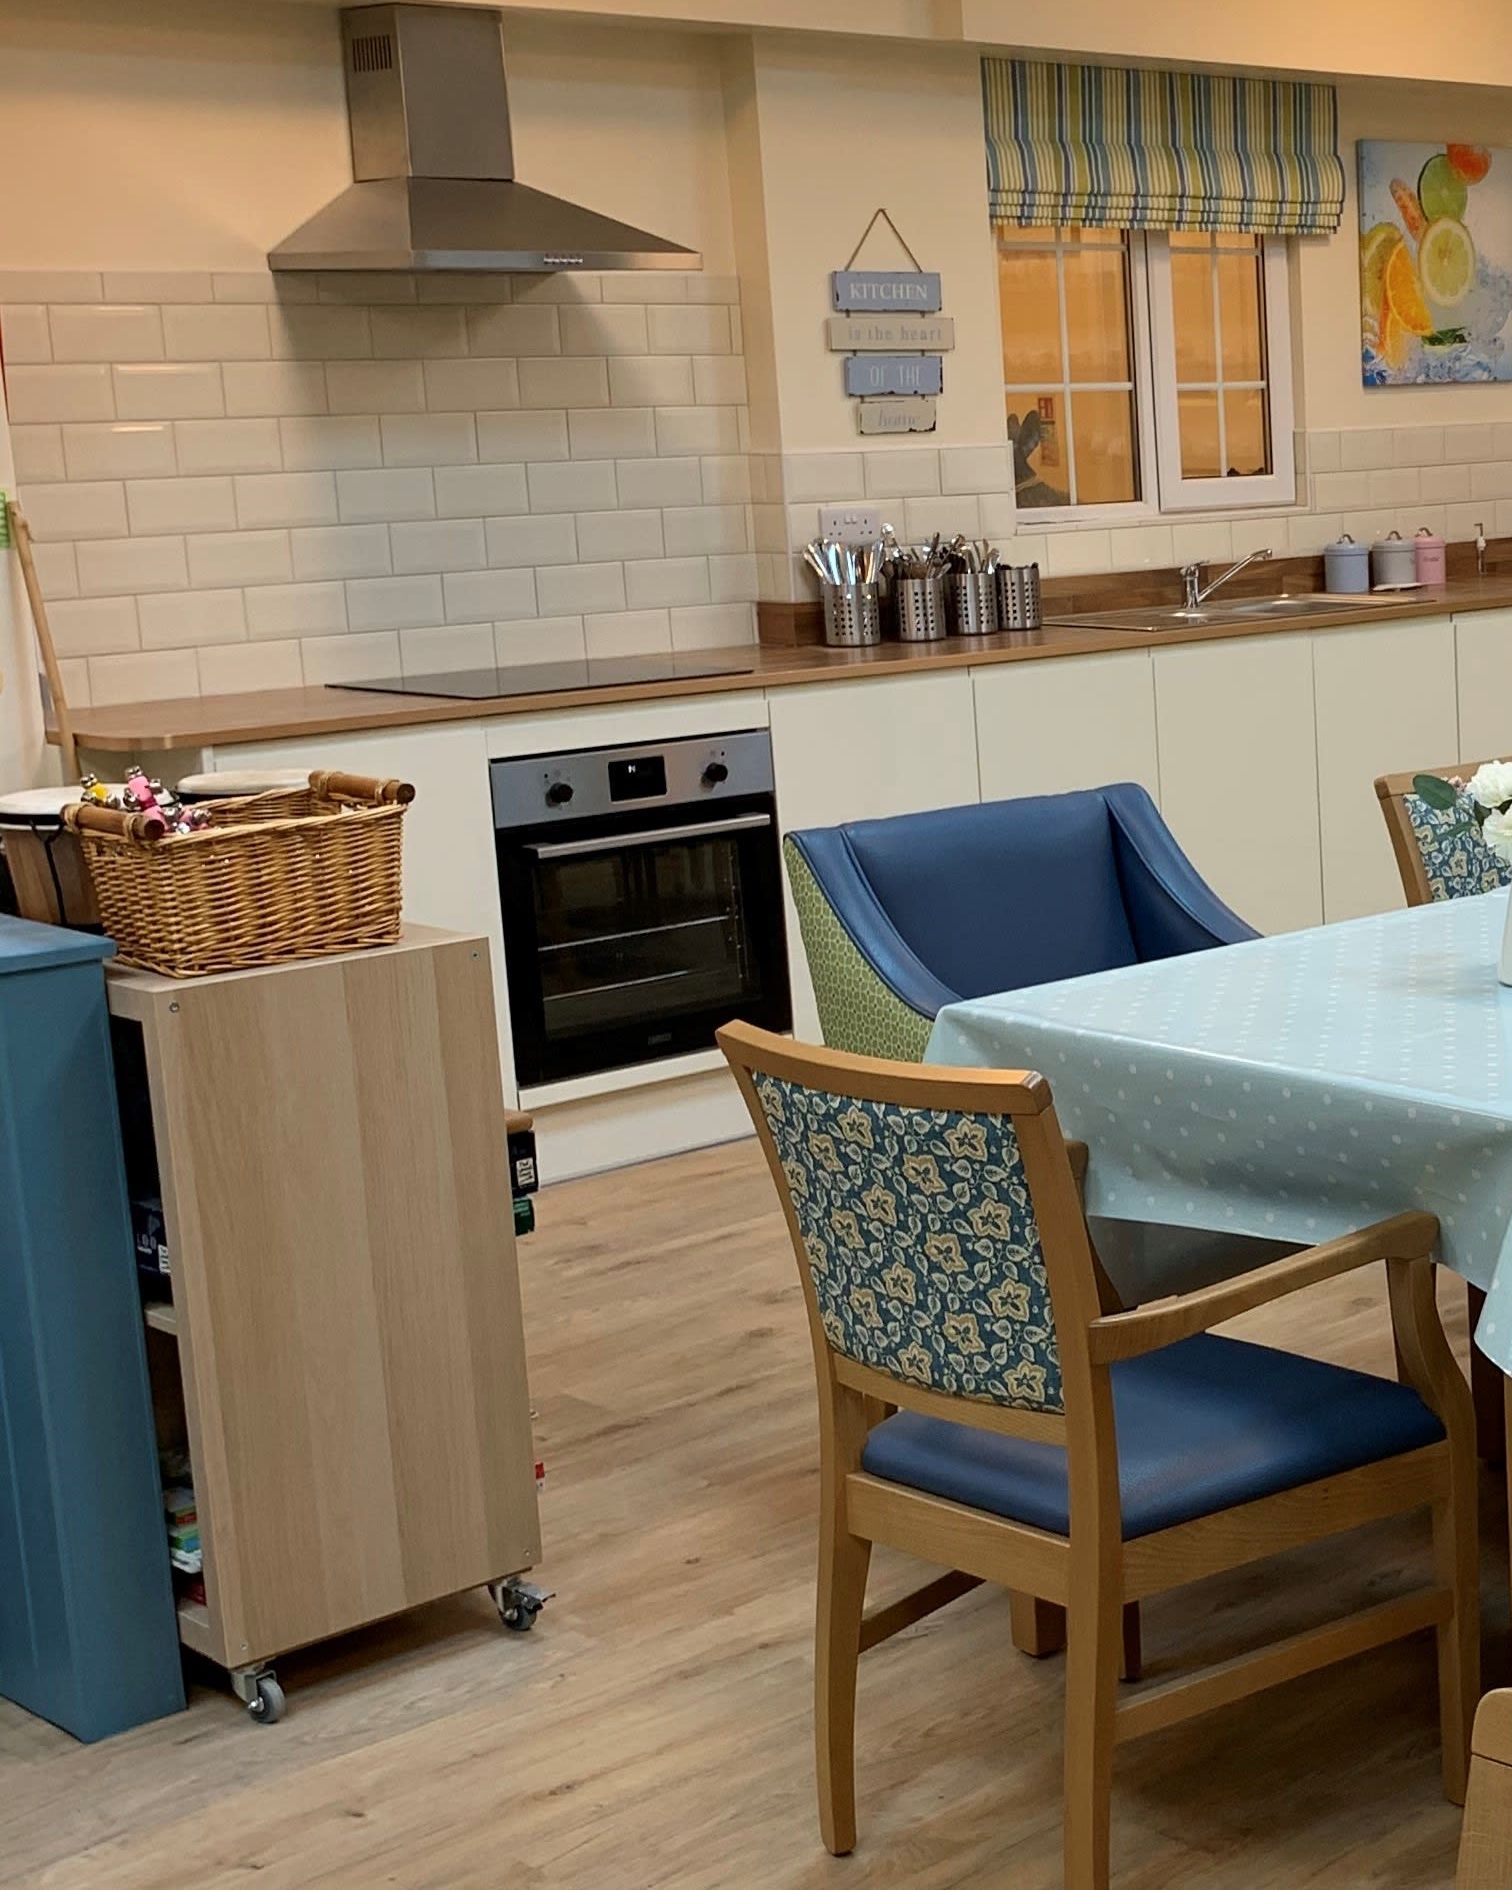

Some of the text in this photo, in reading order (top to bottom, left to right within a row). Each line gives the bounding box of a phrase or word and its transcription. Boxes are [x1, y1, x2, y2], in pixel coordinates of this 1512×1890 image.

[849, 283, 929, 300] KITCHEN
[867, 326, 893, 340] the
[900, 325, 942, 341] heart
